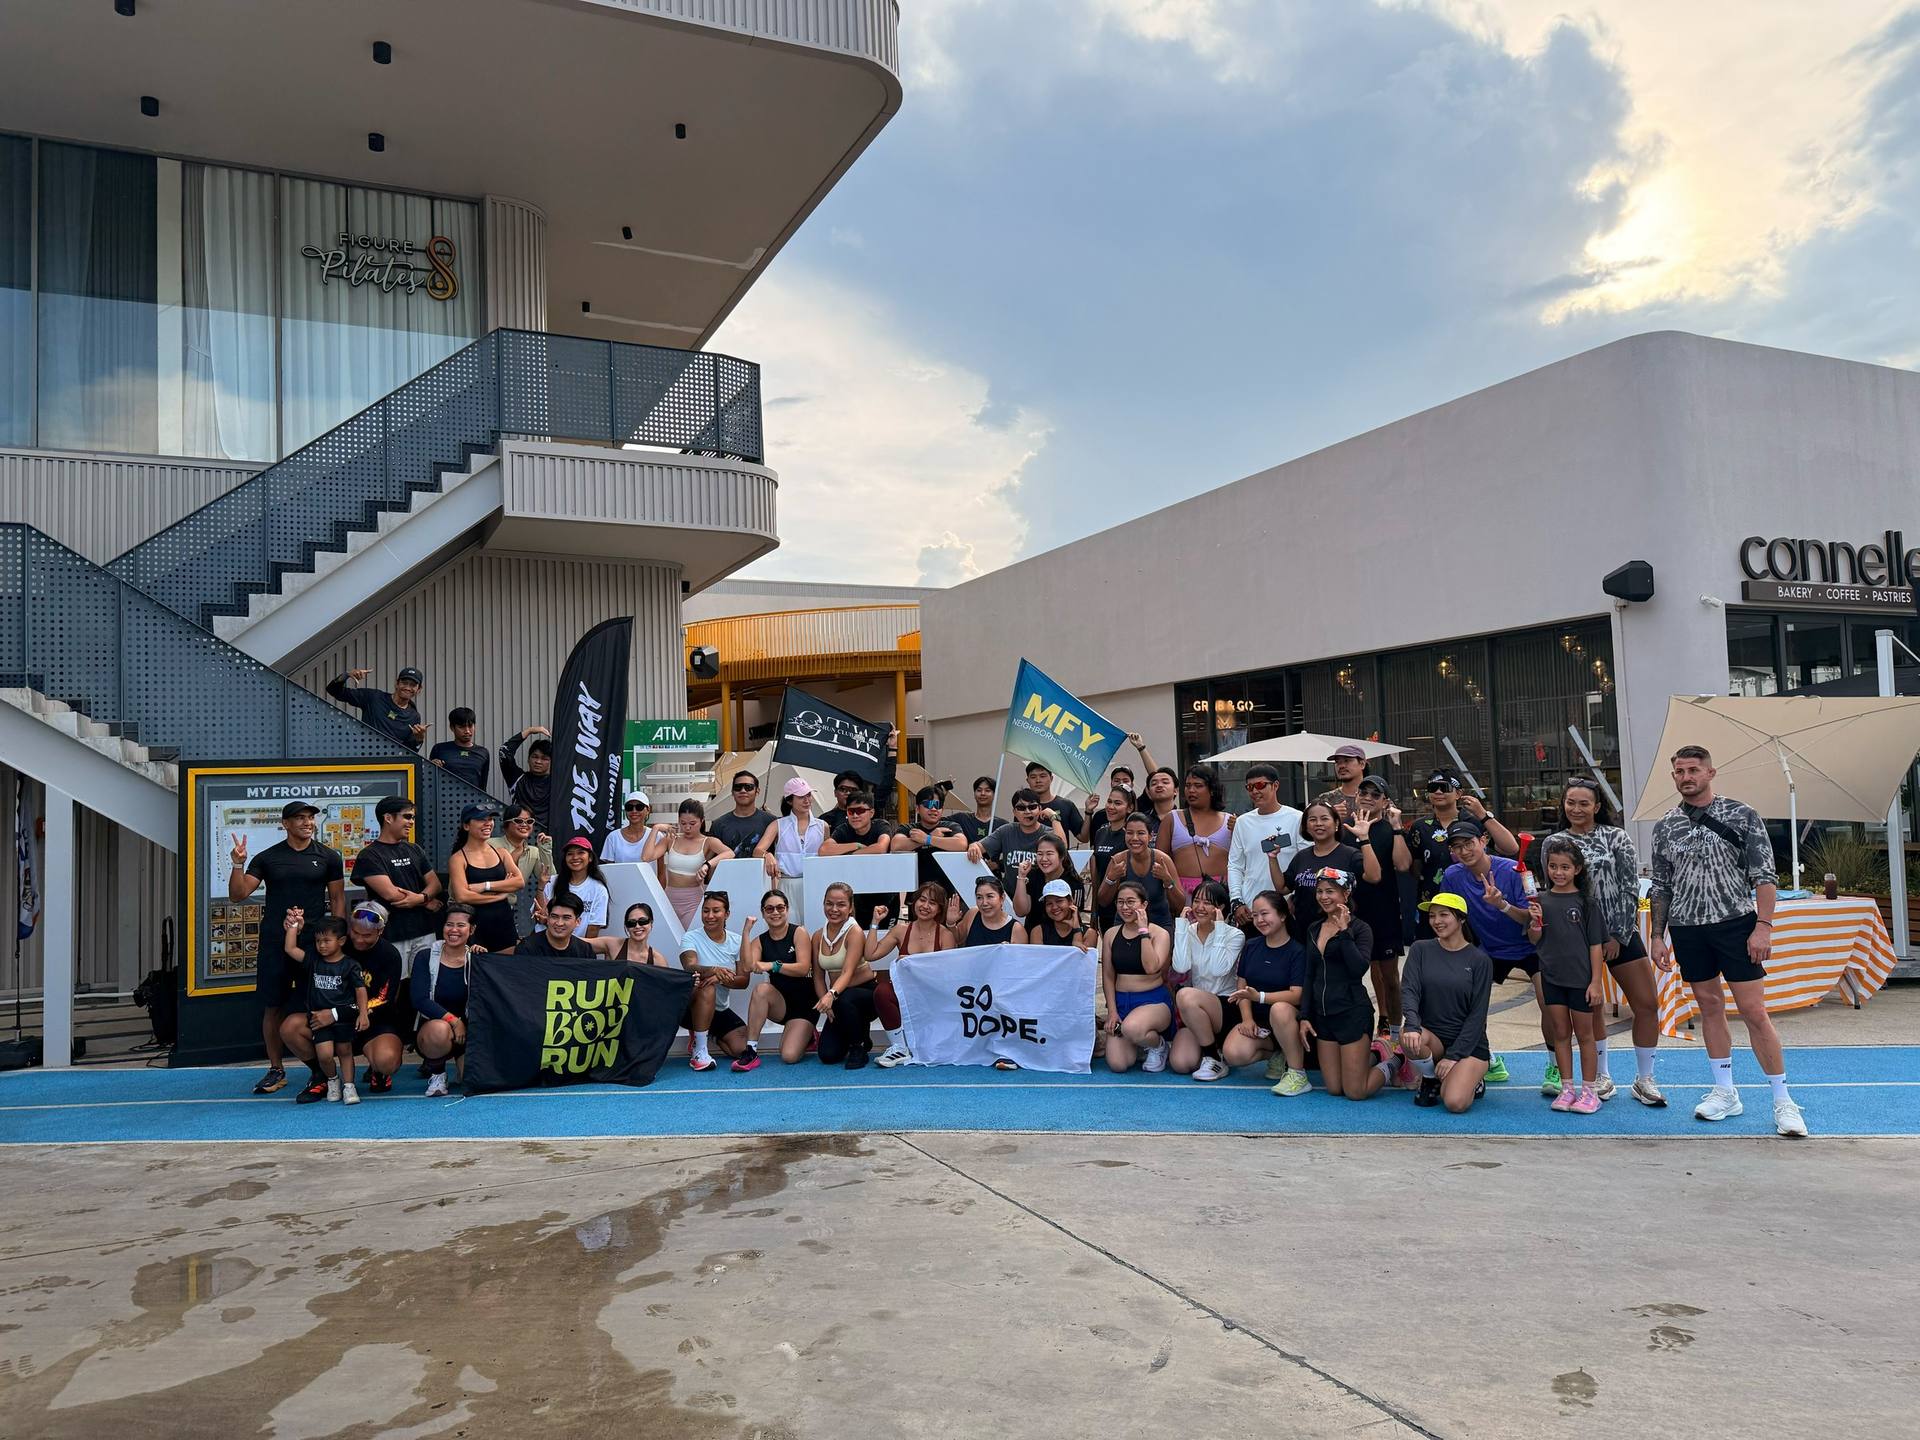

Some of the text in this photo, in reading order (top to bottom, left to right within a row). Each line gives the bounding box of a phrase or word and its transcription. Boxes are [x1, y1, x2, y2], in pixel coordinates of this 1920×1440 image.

[338, 232, 415, 255] FIGURE
[301, 245, 425, 295] Pilates
[1777, 586, 1912, 603] BAKERY COFFEE PASTRIES
[1022, 692, 1106, 752] MFY
[1193, 700, 1225, 712] GRB
[1237, 700, 1254, 712] GO
[652, 726, 687, 741] ATM
[1012, 718, 1093, 768] NEIGHBORHOOD MALL
[570, 681, 602, 835] THE WAY
[246, 785, 361, 798] MY FRONT YARD
[1006, 850, 1037, 866] SATISF
[546, 977, 635, 1010] RUN
[957, 984, 993, 1012] SO
[542, 1003, 629, 1047] BOY
[961, 1012, 1047, 1045] DOPE.
[540, 1039, 620, 1075] RUN
